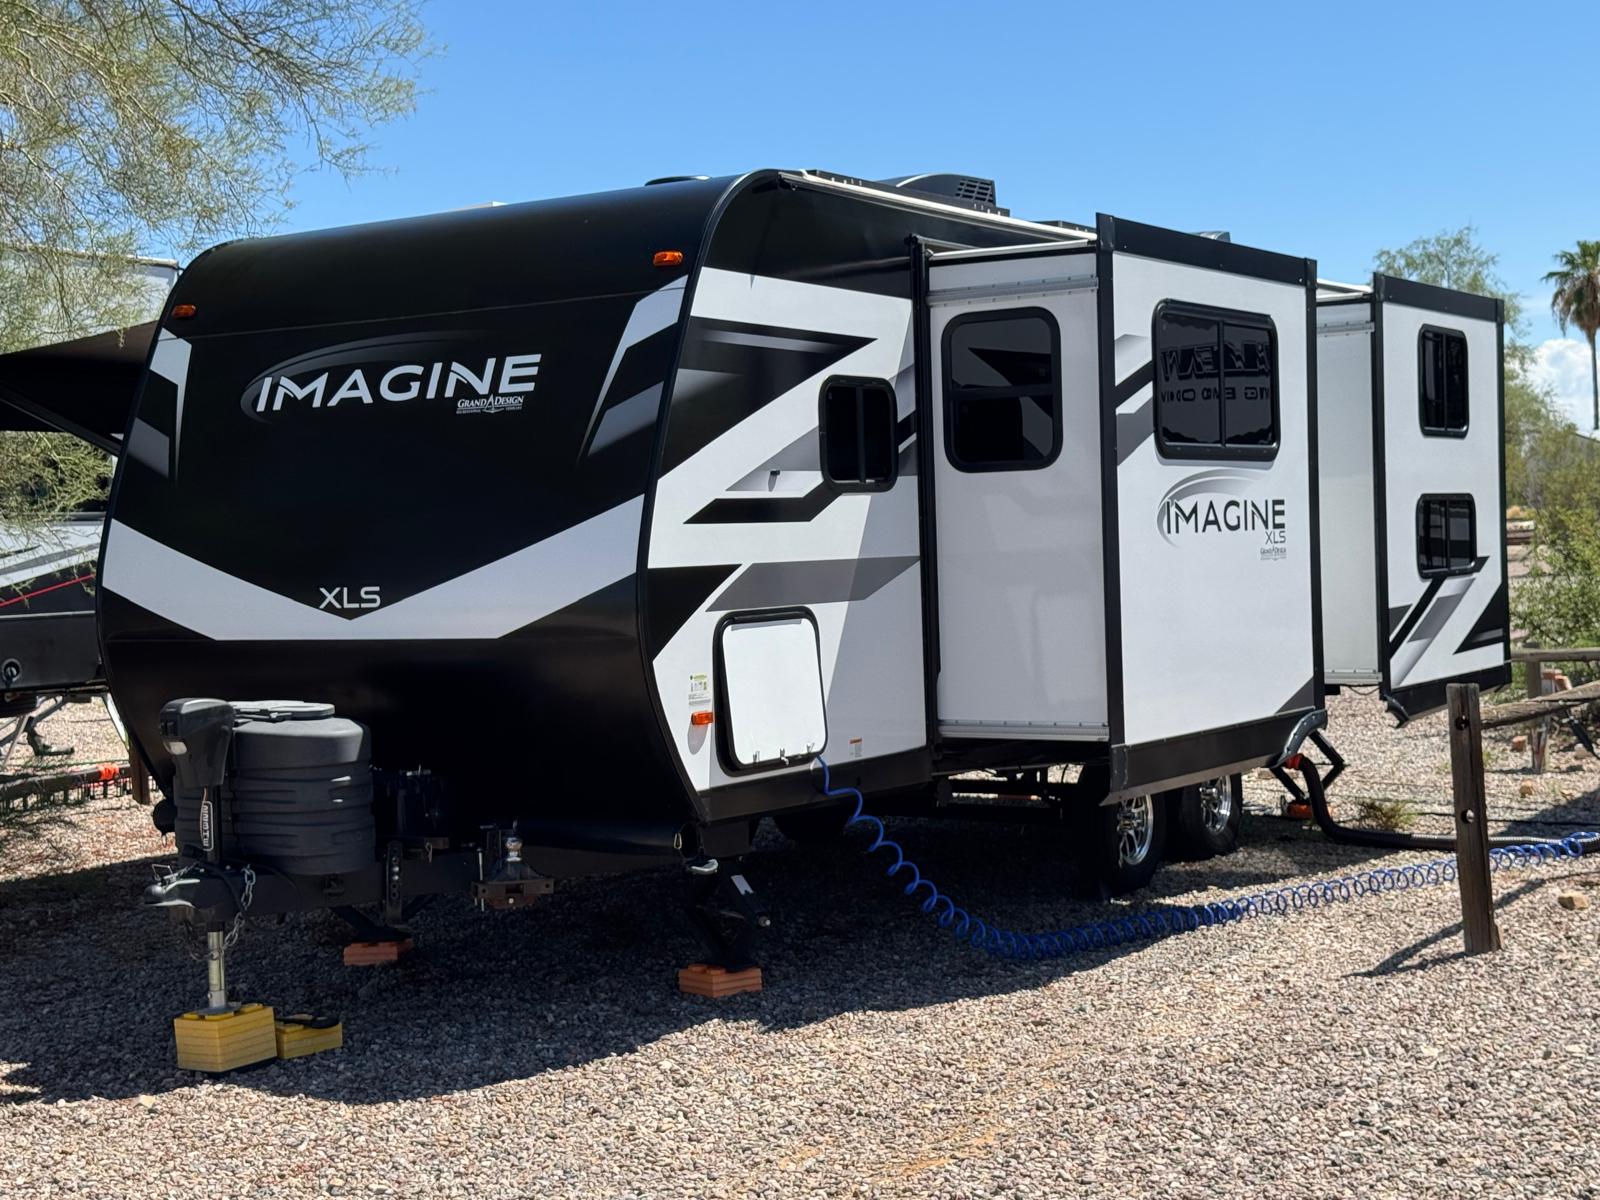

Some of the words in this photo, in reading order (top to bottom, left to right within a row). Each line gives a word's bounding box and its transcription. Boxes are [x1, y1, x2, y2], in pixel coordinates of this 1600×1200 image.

[256, 354, 542, 412] IMAGINE
[457, 398, 487, 408] GRAND
[494, 395, 524, 405] DESIGN
[1166, 499, 1286, 534] IMAGINE
[1265, 530, 1286, 544] XLS
[319, 586, 381, 609] XLS
